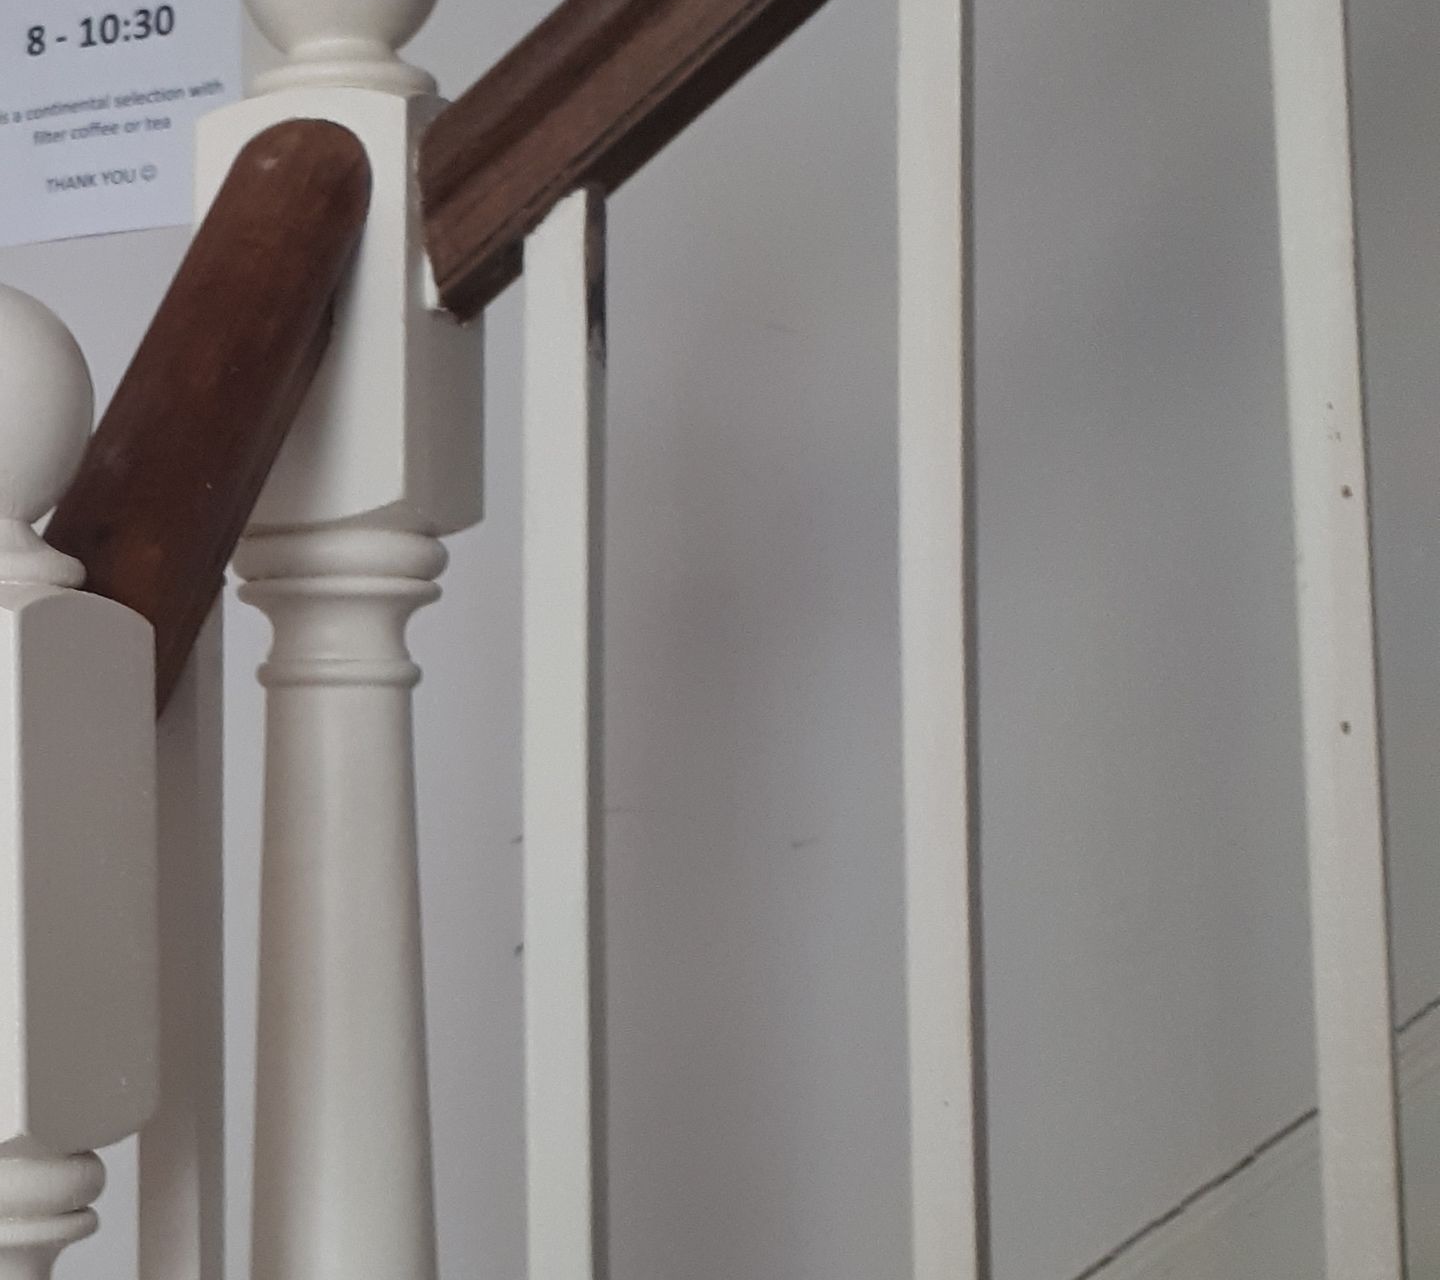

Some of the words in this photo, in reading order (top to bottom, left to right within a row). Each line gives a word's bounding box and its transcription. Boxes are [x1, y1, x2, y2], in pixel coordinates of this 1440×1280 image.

[25, 25, 46, 57] 8
[78, 4, 176, 50] 10:30
[25, 94, 110, 122] continental
[114, 85, 186, 110] selection
[189, 78, 225, 99] with
[32, 125, 67, 146] filter
[70, 120, 120, 141] coffee
[124, 118, 142, 135] or
[145, 115, 172, 132] tea
[45, 173, 97, 194] THANK
[103, 168, 137, 187] YOU
